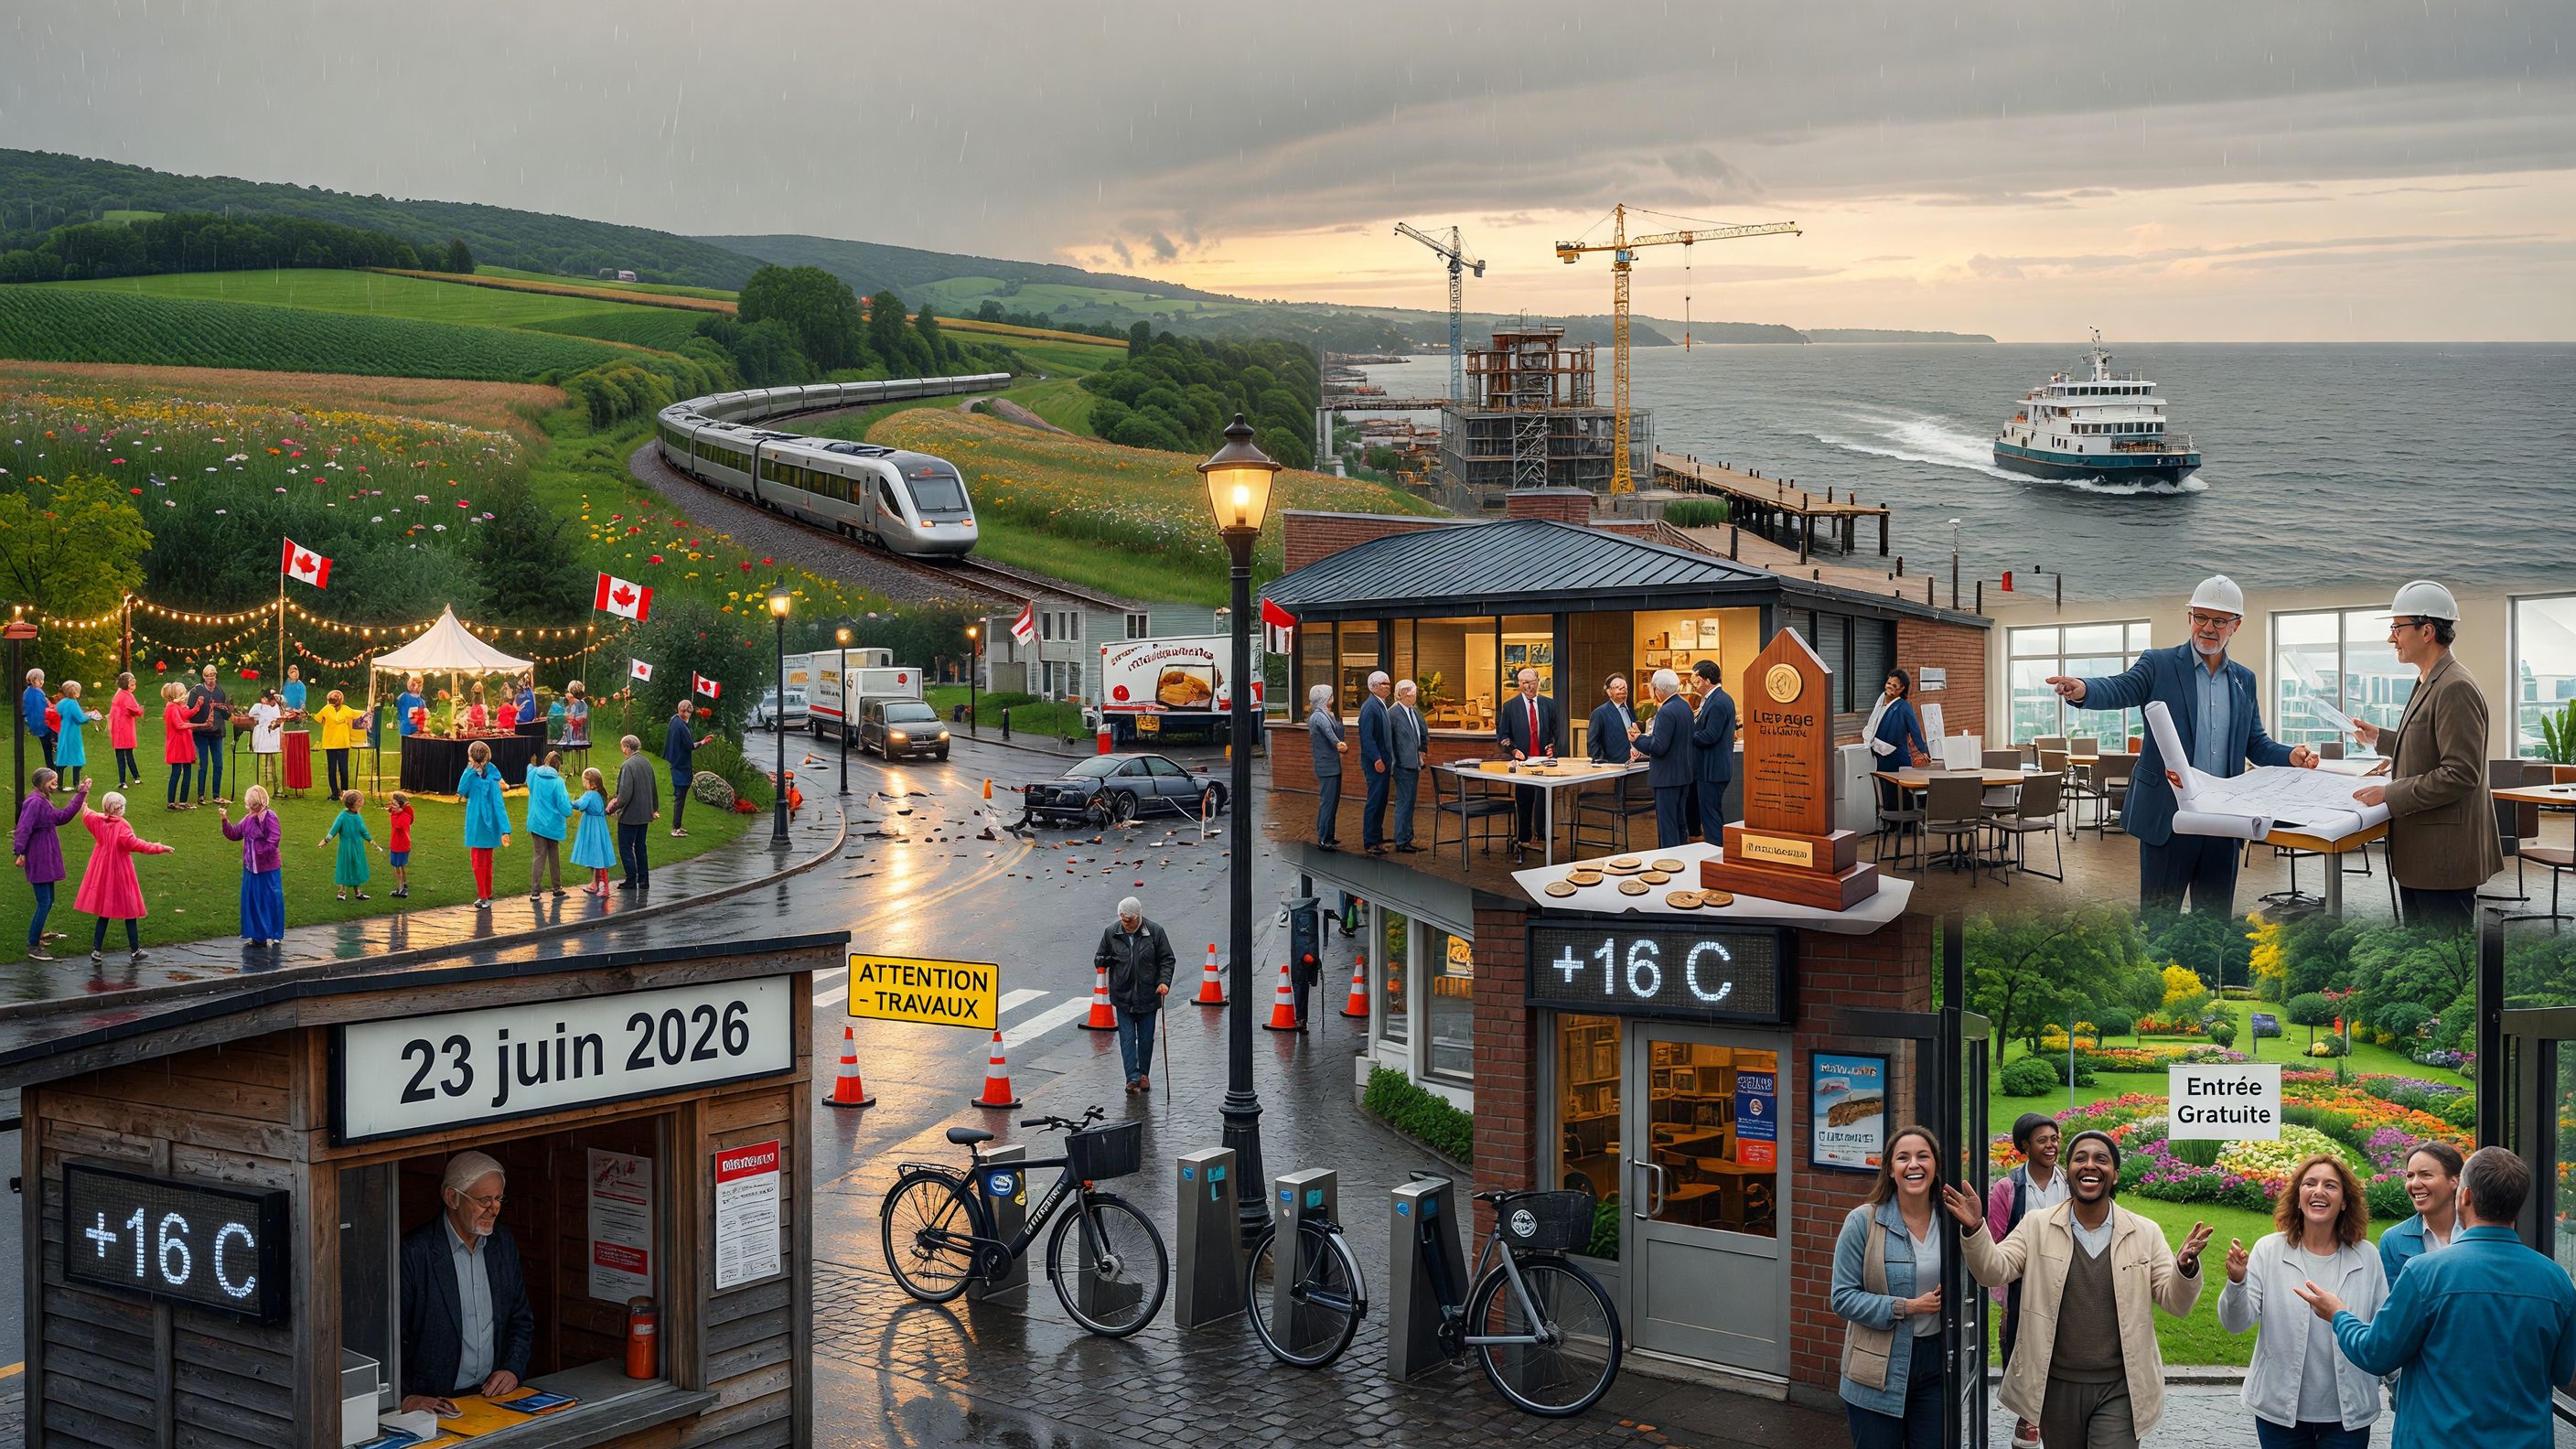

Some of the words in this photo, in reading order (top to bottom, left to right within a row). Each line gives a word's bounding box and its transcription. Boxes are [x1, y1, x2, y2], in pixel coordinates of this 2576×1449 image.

[859, 963, 988, 993] ATTENTION
[1553, 938, 1661, 998] +16
[1687, 941, 1733, 1002] C
[875, 991, 979, 1020] TRAVAUX
[400, 1034, 474, 1105] 23
[490, 1022, 604, 1109] juin
[625, 1000, 750, 1072] 2026
[2187, 1075, 2262, 1097] Entrée
[2177, 1104, 2271, 1124] Gratuite
[85, 1208, 191, 1285] +16
[214, 1223, 256, 1298] C
